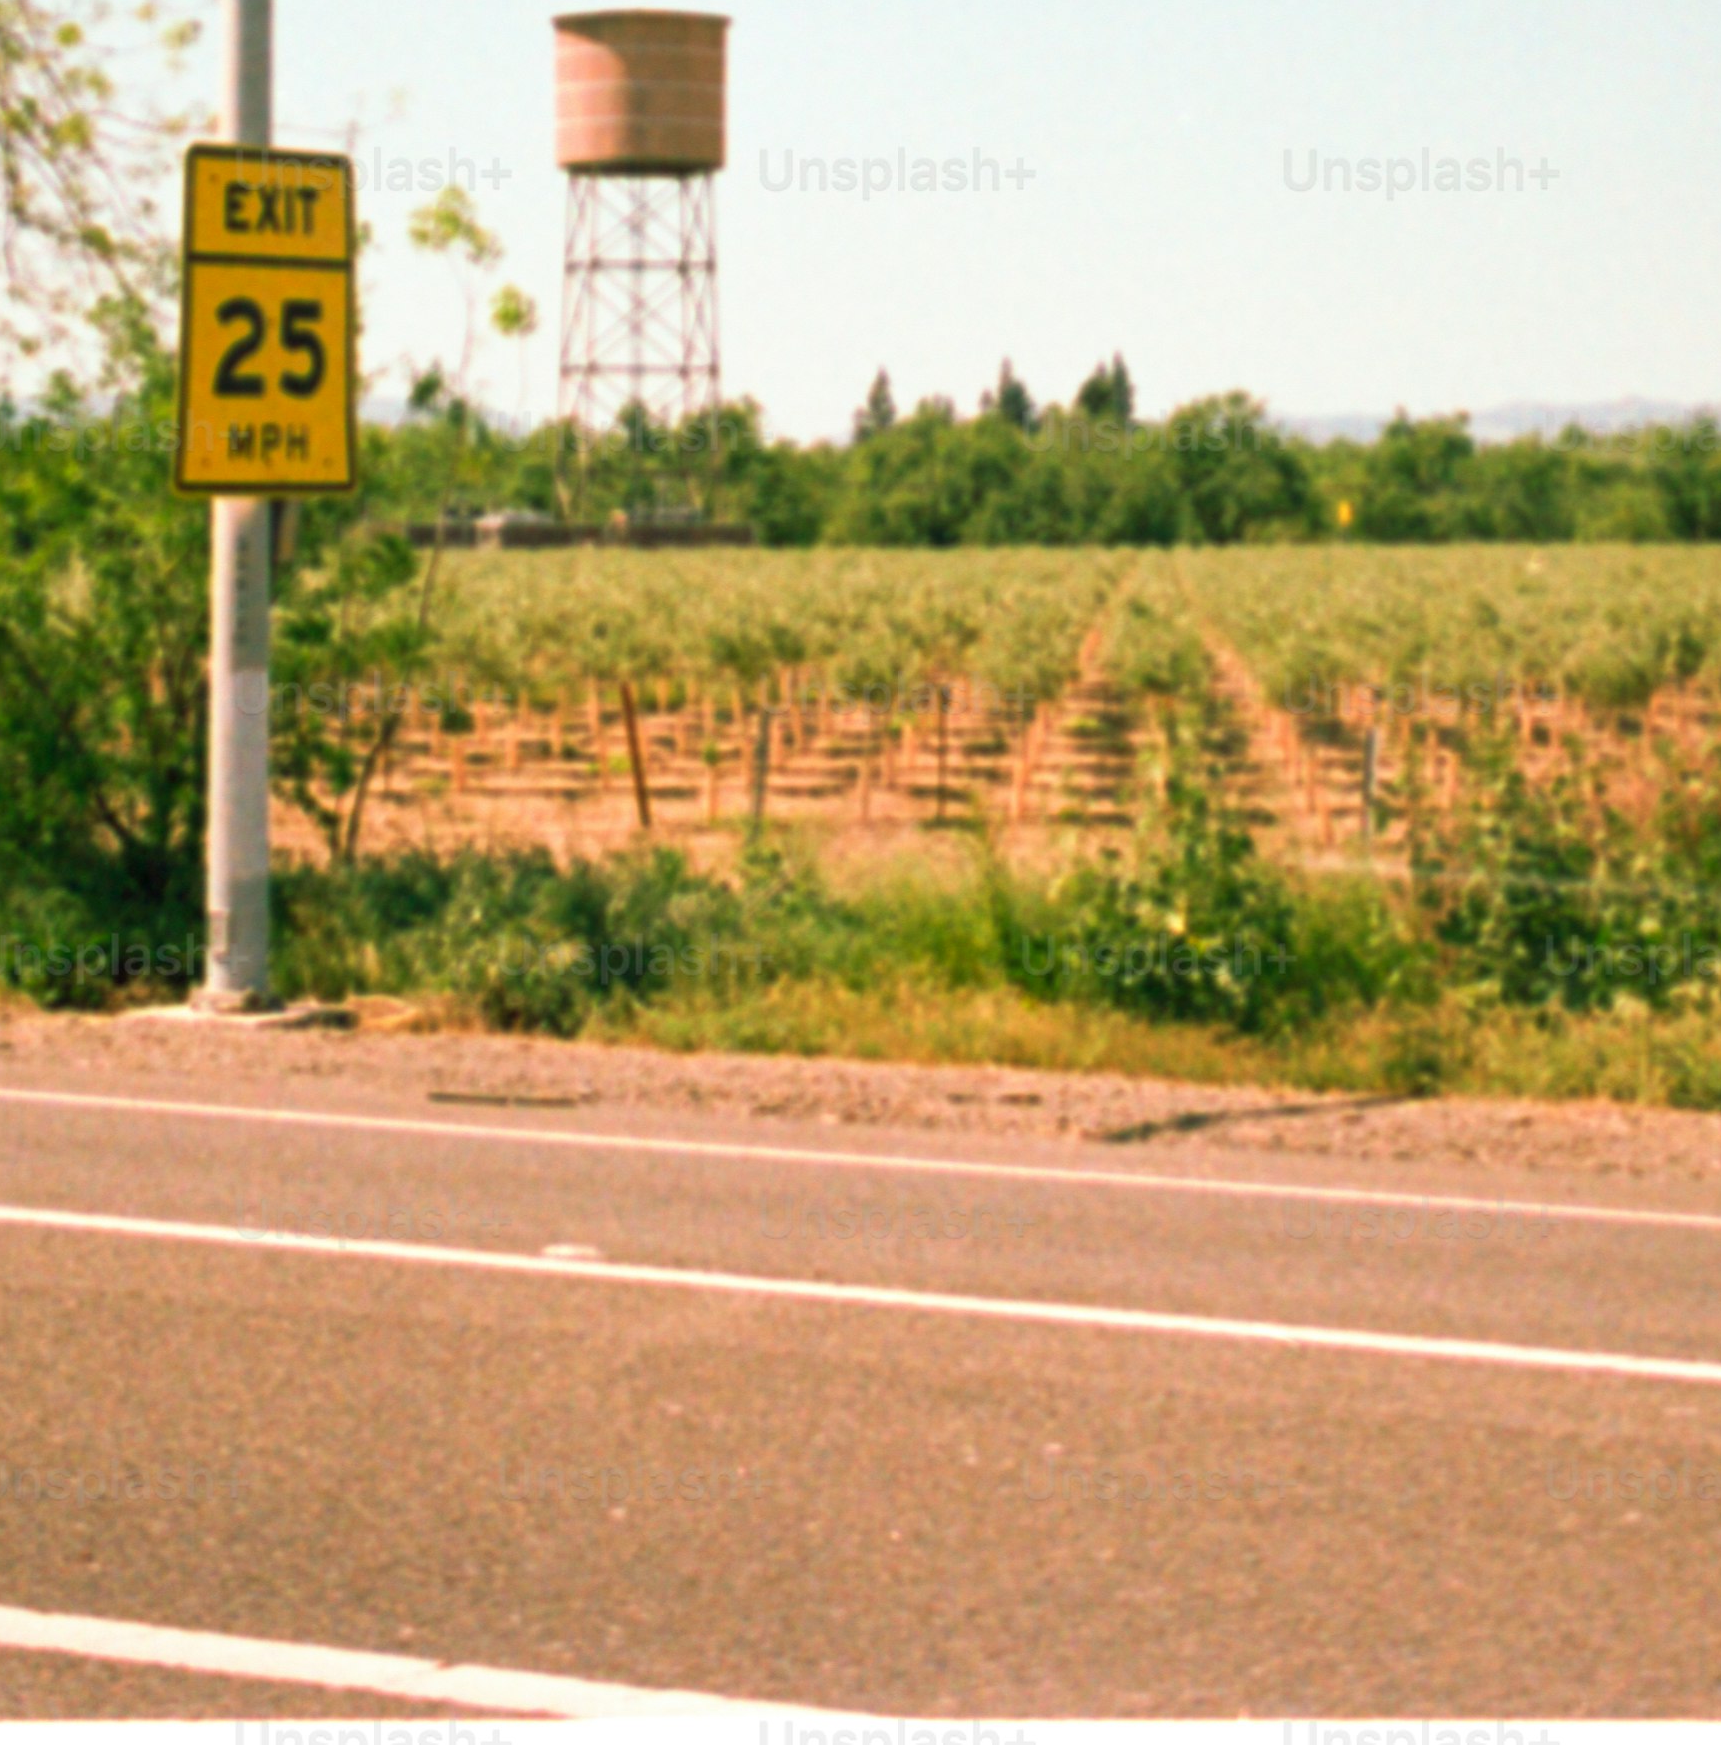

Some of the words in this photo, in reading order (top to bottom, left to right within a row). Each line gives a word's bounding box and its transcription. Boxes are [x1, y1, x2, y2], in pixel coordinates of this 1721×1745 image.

[223, 180, 320, 236] EXIT
[212, 296, 327, 398] 25
[226, 422, 310, 461] MPH
